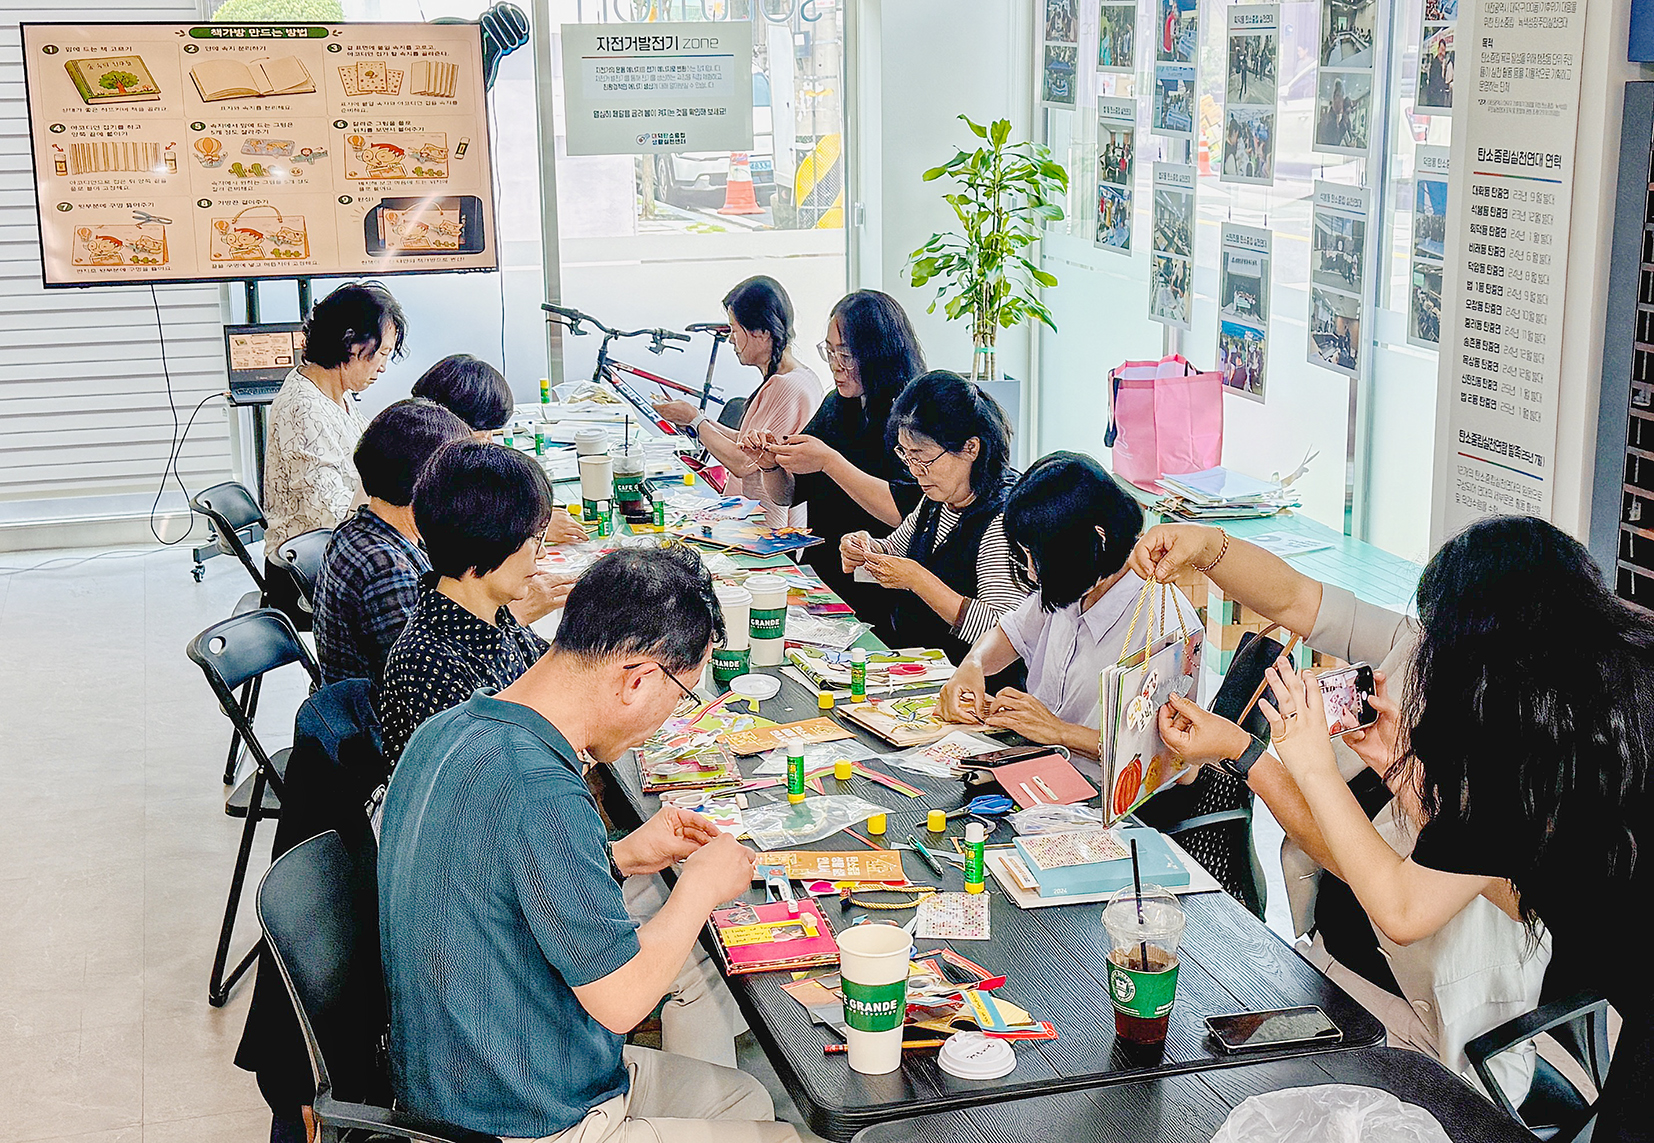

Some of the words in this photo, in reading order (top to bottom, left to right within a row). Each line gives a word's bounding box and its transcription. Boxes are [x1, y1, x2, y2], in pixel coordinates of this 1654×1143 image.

[210, 28, 246, 37] 책가방
[248, 28, 283, 37] 만드는
[285, 28, 307, 37] 방법
[596, 36, 679, 51] 자전거발전기
[683, 37, 719, 49] zone
[1477, 147, 1544, 167] 탄소중립실천연대
[750, 618, 780, 626] GRANDE
[850, 999, 897, 1012] GRANDE
